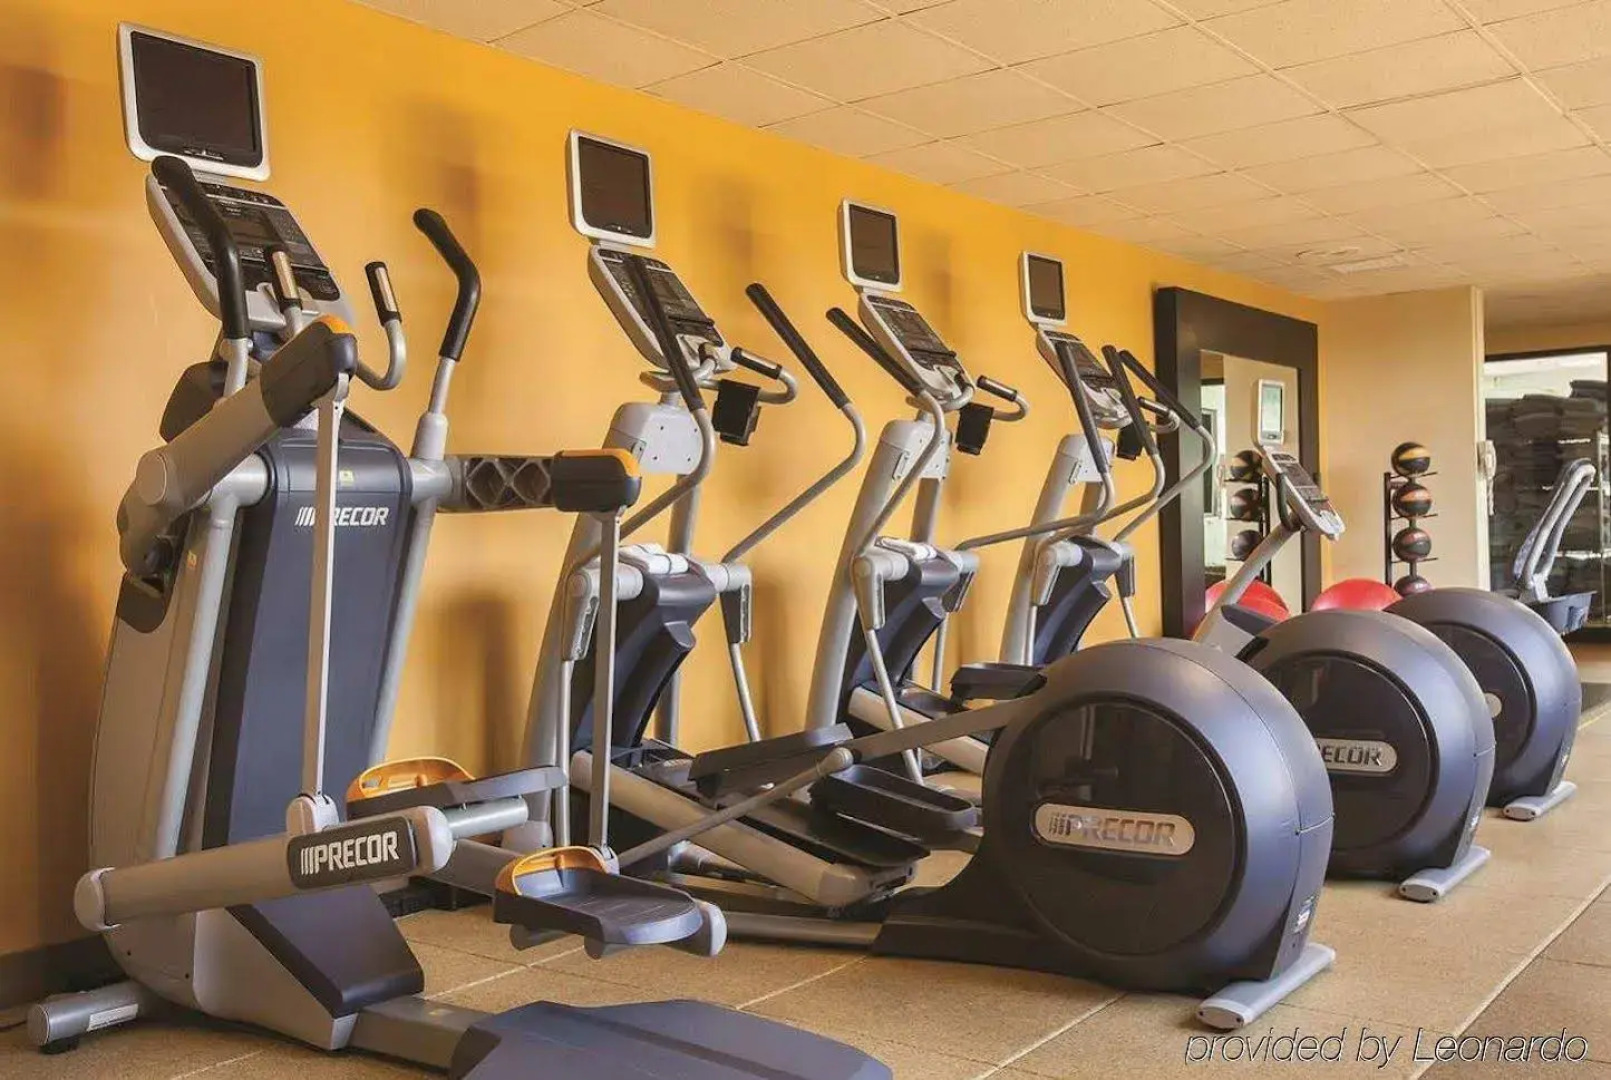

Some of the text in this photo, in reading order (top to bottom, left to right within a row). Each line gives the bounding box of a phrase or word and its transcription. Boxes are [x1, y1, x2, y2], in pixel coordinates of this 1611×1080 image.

[1319, 744, 1382, 767] ECOR
[1063, 812, 1176, 847] PRECOR
[313, 831, 400, 875] PRECOR
